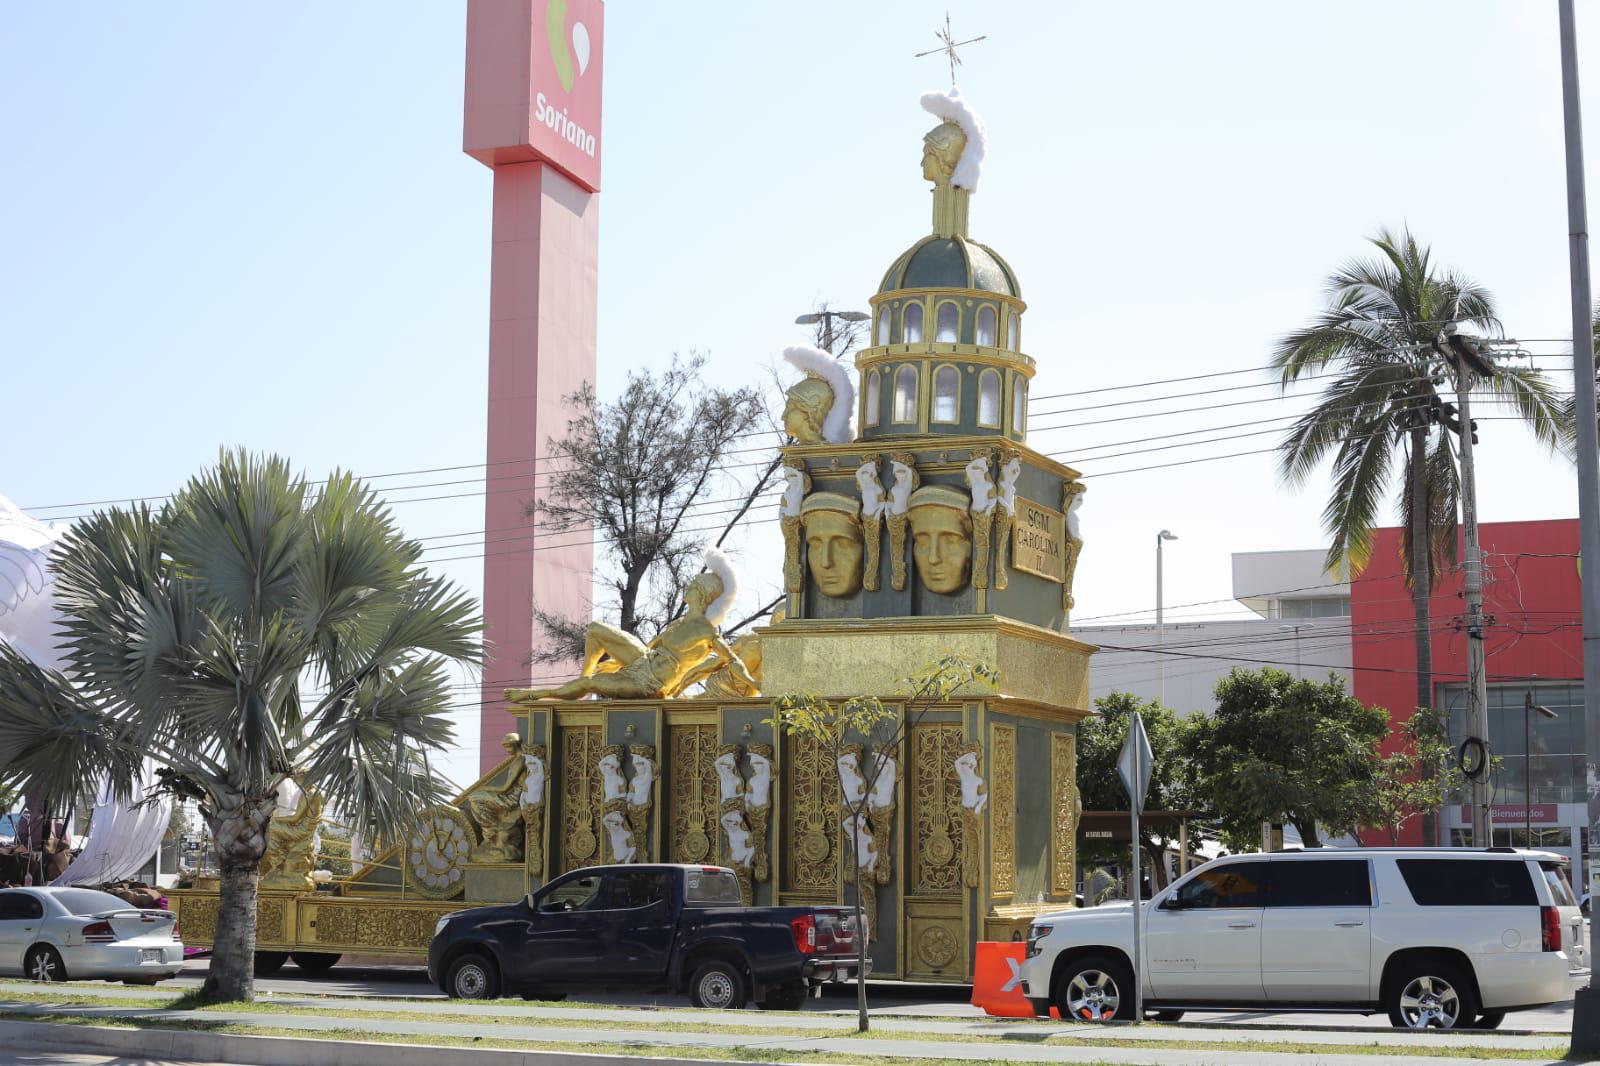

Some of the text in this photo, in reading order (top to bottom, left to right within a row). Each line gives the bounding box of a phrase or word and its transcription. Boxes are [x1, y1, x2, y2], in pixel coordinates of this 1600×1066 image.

[535, 92, 595, 158] Soriana
[1028, 508, 1049, 533] SGM
[1017, 528, 1059, 559] CAROLINA
[1491, 809, 1544, 818] Bienvendos
